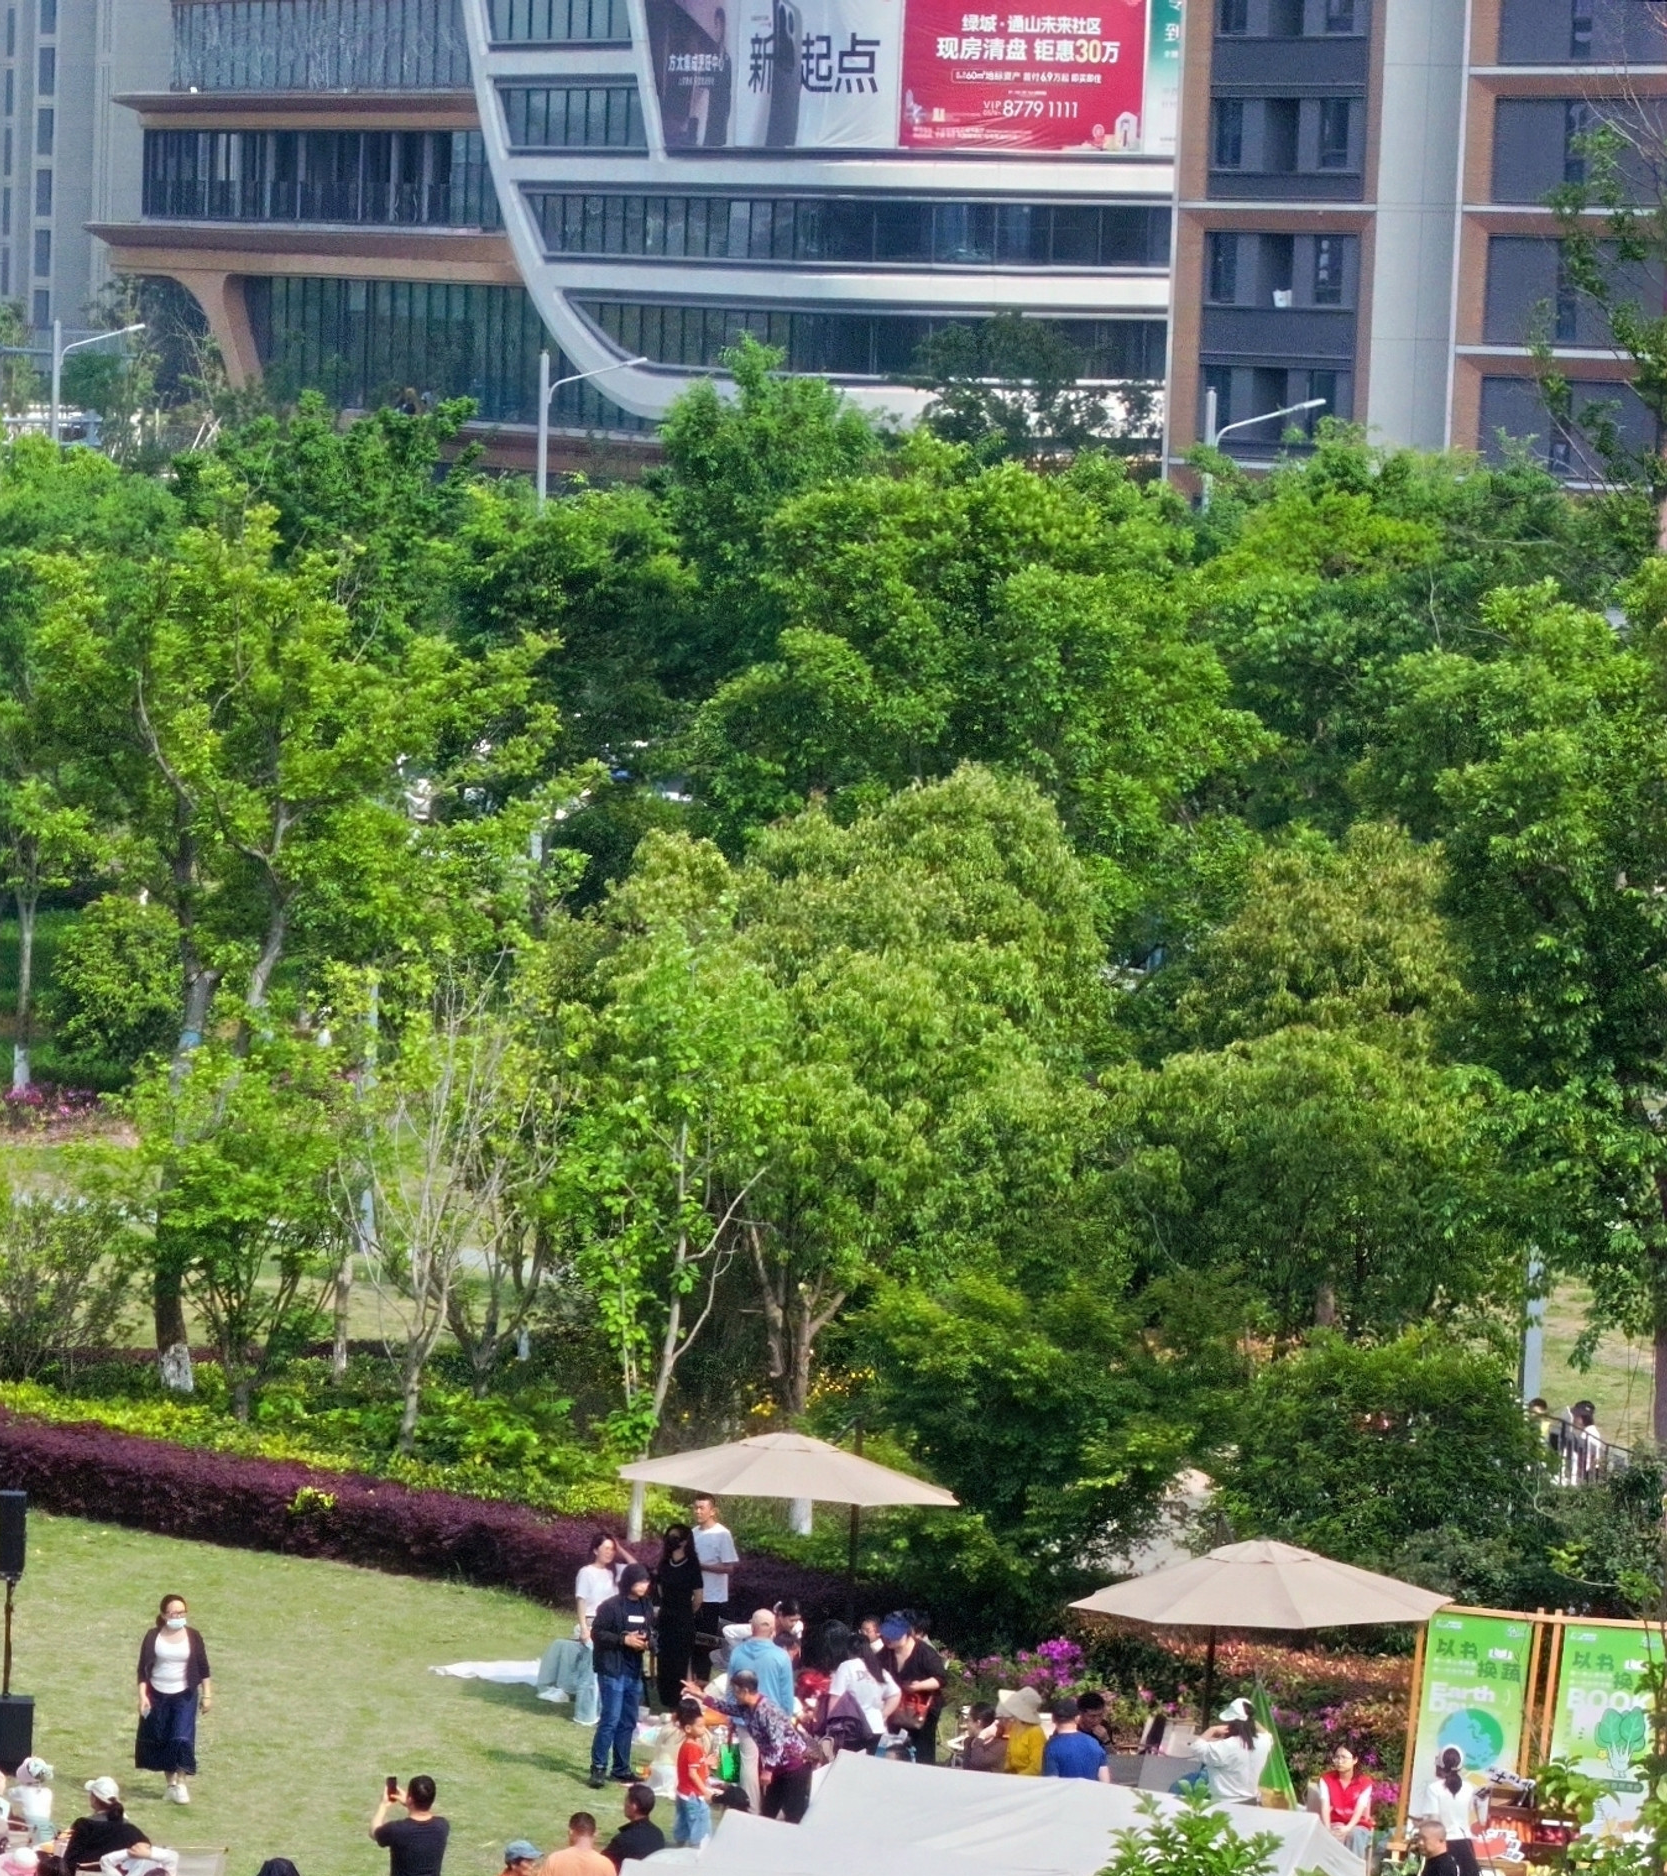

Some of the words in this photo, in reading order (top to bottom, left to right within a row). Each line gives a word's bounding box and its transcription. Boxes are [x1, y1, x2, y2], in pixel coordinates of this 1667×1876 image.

[961, 14, 1102, 35] 绿城·通山未来社区
[936, 37, 1028, 61] 现房清盘
[1033, 39, 1121, 63] 钜惠30万
[983, 100, 1001, 109] VIP
[1002, 100, 1044, 118] 8779
[1048, 101, 1078, 118] 1111
[1436, 1638, 1478, 1660] 以书
[1477, 1660, 1522, 1683] 换蔬
[1572, 1651, 1615, 1672] 以书
[1431, 1681, 1496, 1703] Earth
